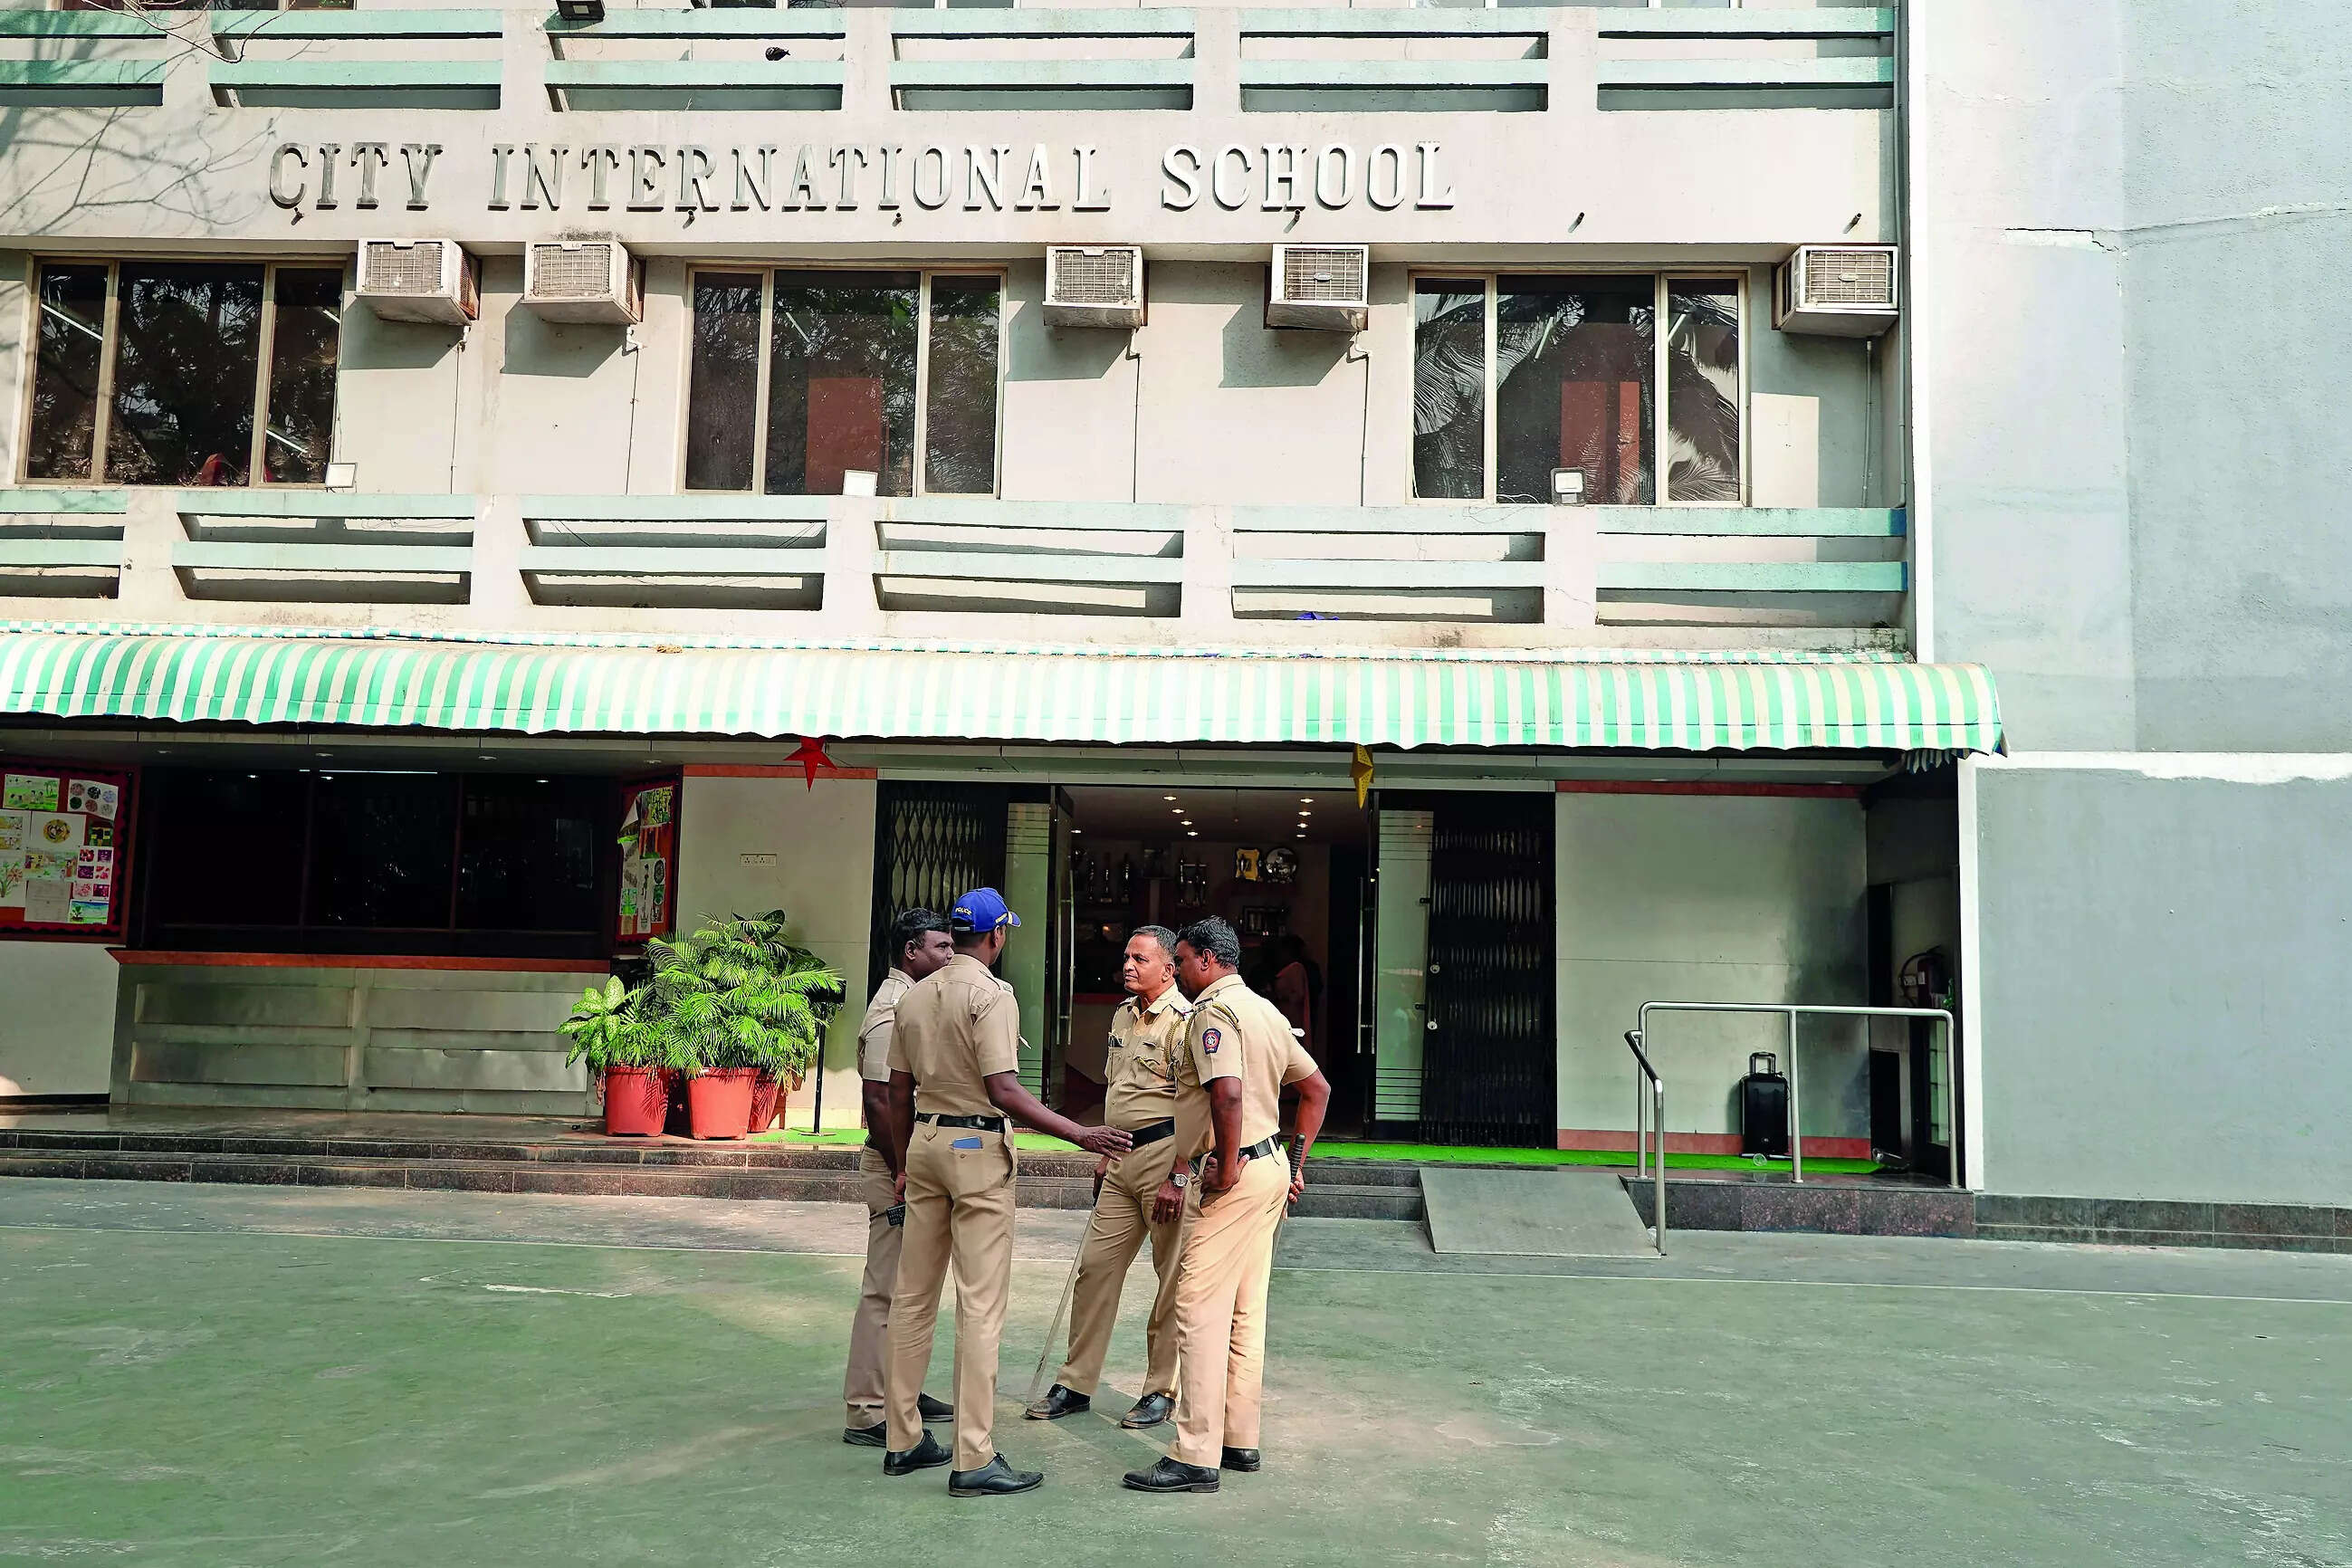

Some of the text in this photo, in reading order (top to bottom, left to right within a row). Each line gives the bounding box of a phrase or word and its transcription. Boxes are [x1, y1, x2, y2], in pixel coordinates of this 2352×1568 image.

[270, 141, 1456, 213] CITY INTERNATIONAL SCHOOL
[955, 906, 972, 916] POLICE
